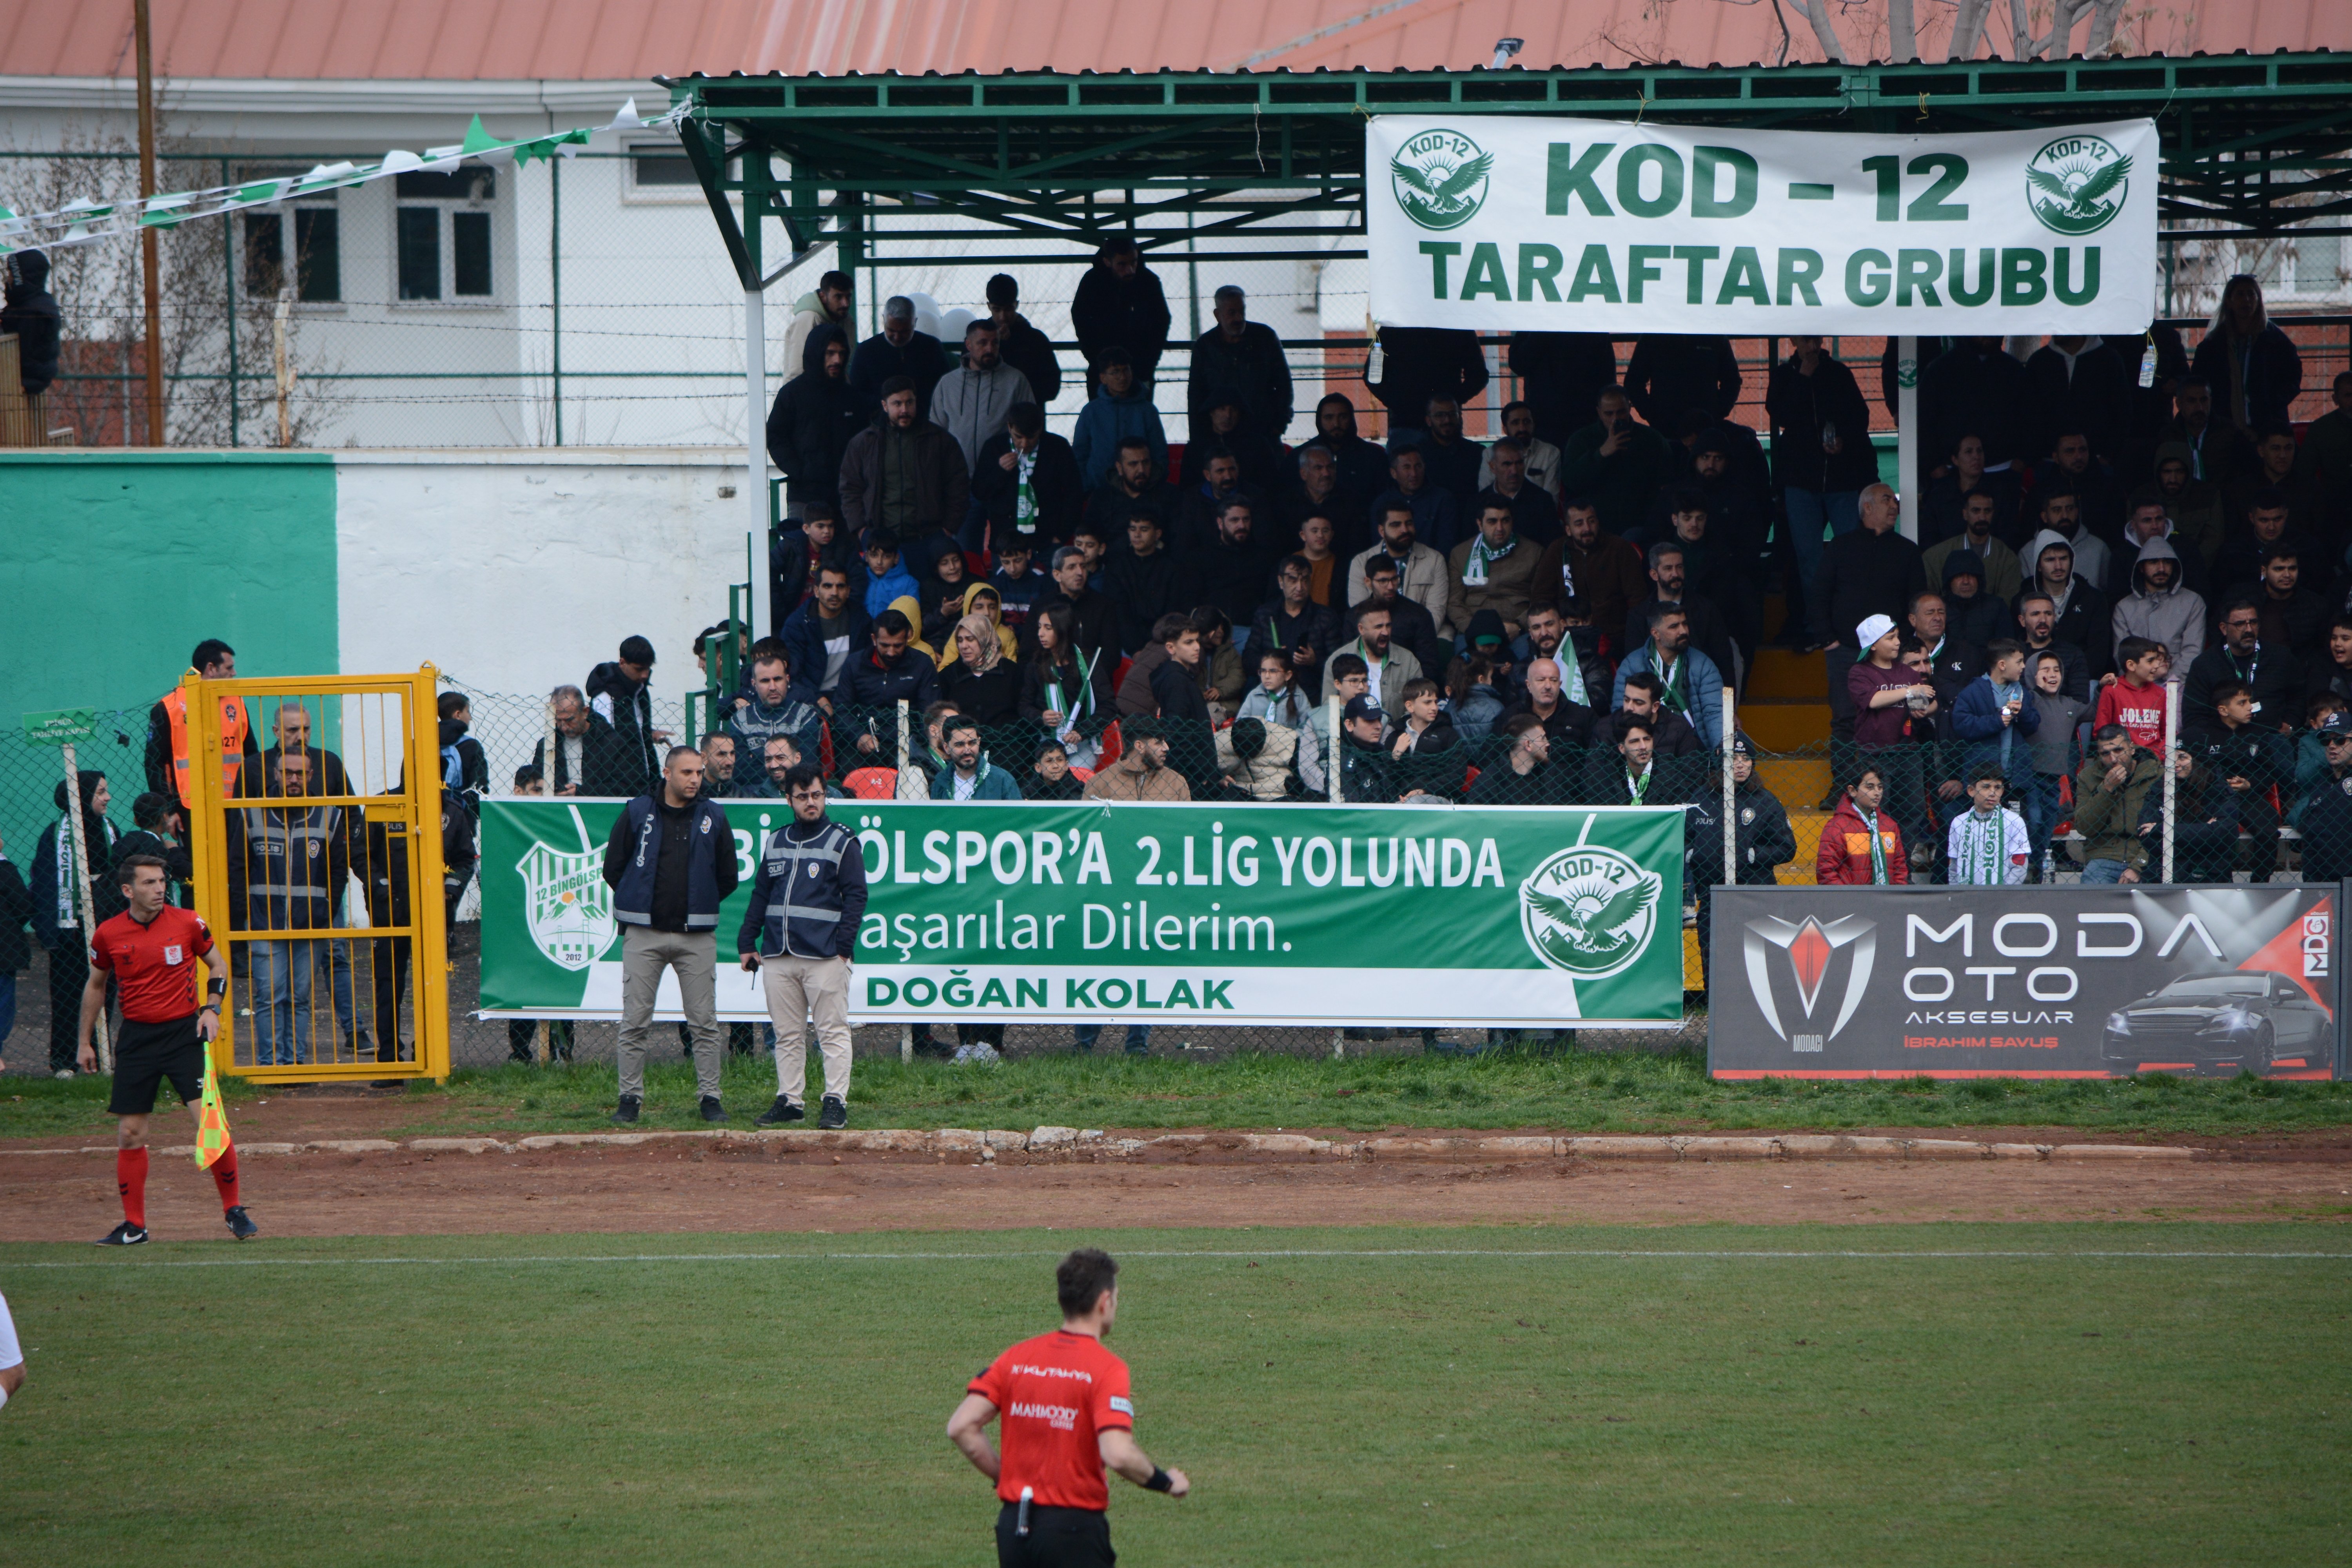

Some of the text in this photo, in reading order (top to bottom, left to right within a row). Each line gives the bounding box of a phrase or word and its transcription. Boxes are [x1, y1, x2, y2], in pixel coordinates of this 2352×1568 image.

[1409, 135, 1470, 158] KOD-12
[2041, 140, 2108, 164] KOD-12
[1546, 143, 1759, 218] KOD
[1862, 153, 1969, 221] 12
[1419, 241, 2100, 307] TARAFTAR GRUBU
[2119, 708, 2161, 724] JOLENE
[222, 737, 236, 747] 27
[1136, 821, 1259, 886] 2.LİG
[1272, 836, 1505, 887] YOLUNDA
[535, 867, 604, 902] 12 BİNGÖLSP
[1549, 858, 1626, 886] KOD-12
[860, 900, 1292, 962] aşarılar Dilerim.
[1907, 913, 2223, 957] MODA
[867, 969, 1235, 1009] DOĞAN KOLAK
[1903, 967, 2078, 1002] OTO
[1905, 1011, 2074, 1024] AKSESUAR
[1793, 1034, 1823, 1052] MODACI
[1989, 1036, 2059, 1049] SAVUŞ
[1010, 1401, 1076, 1422] MAHMOOD
